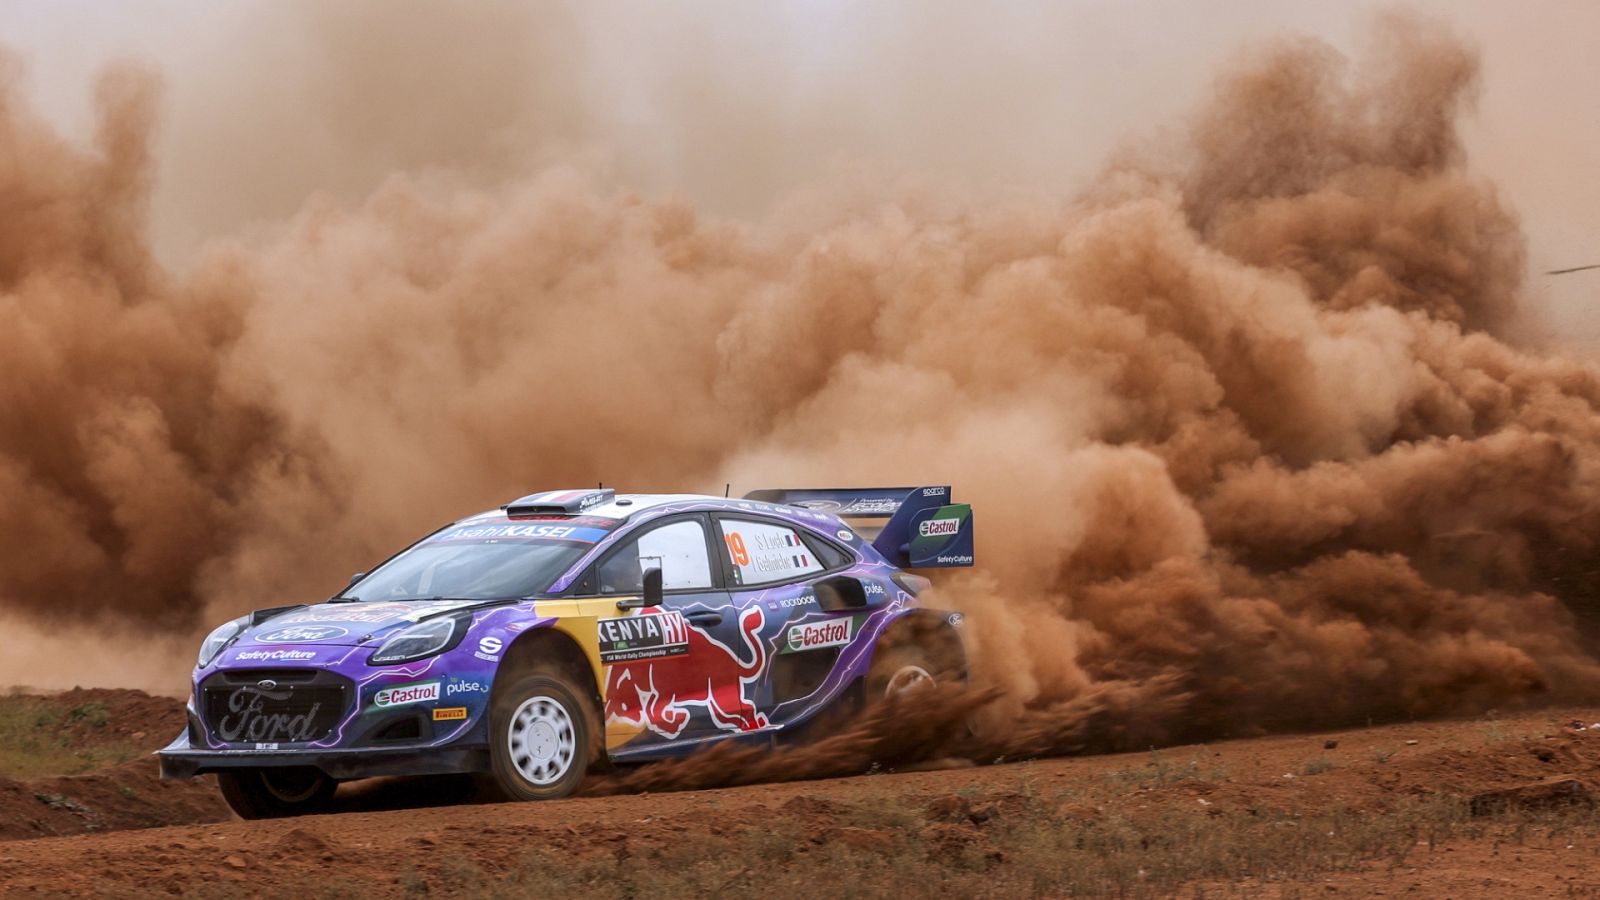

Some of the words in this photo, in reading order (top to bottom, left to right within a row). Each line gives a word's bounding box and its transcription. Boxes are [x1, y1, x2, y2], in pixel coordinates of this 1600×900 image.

[929, 522, 958, 534] Castrol
[724, 532, 749, 566] 19
[865, 584, 884, 595] pulse
[598, 618, 659, 642] KENYA
[804, 620, 850, 647] Castrol
[236, 650, 316, 661] SafetyCulture
[391, 685, 437, 704] Castrol
[446, 680, 480, 697] pulse
[219, 687, 322, 741] Ford
